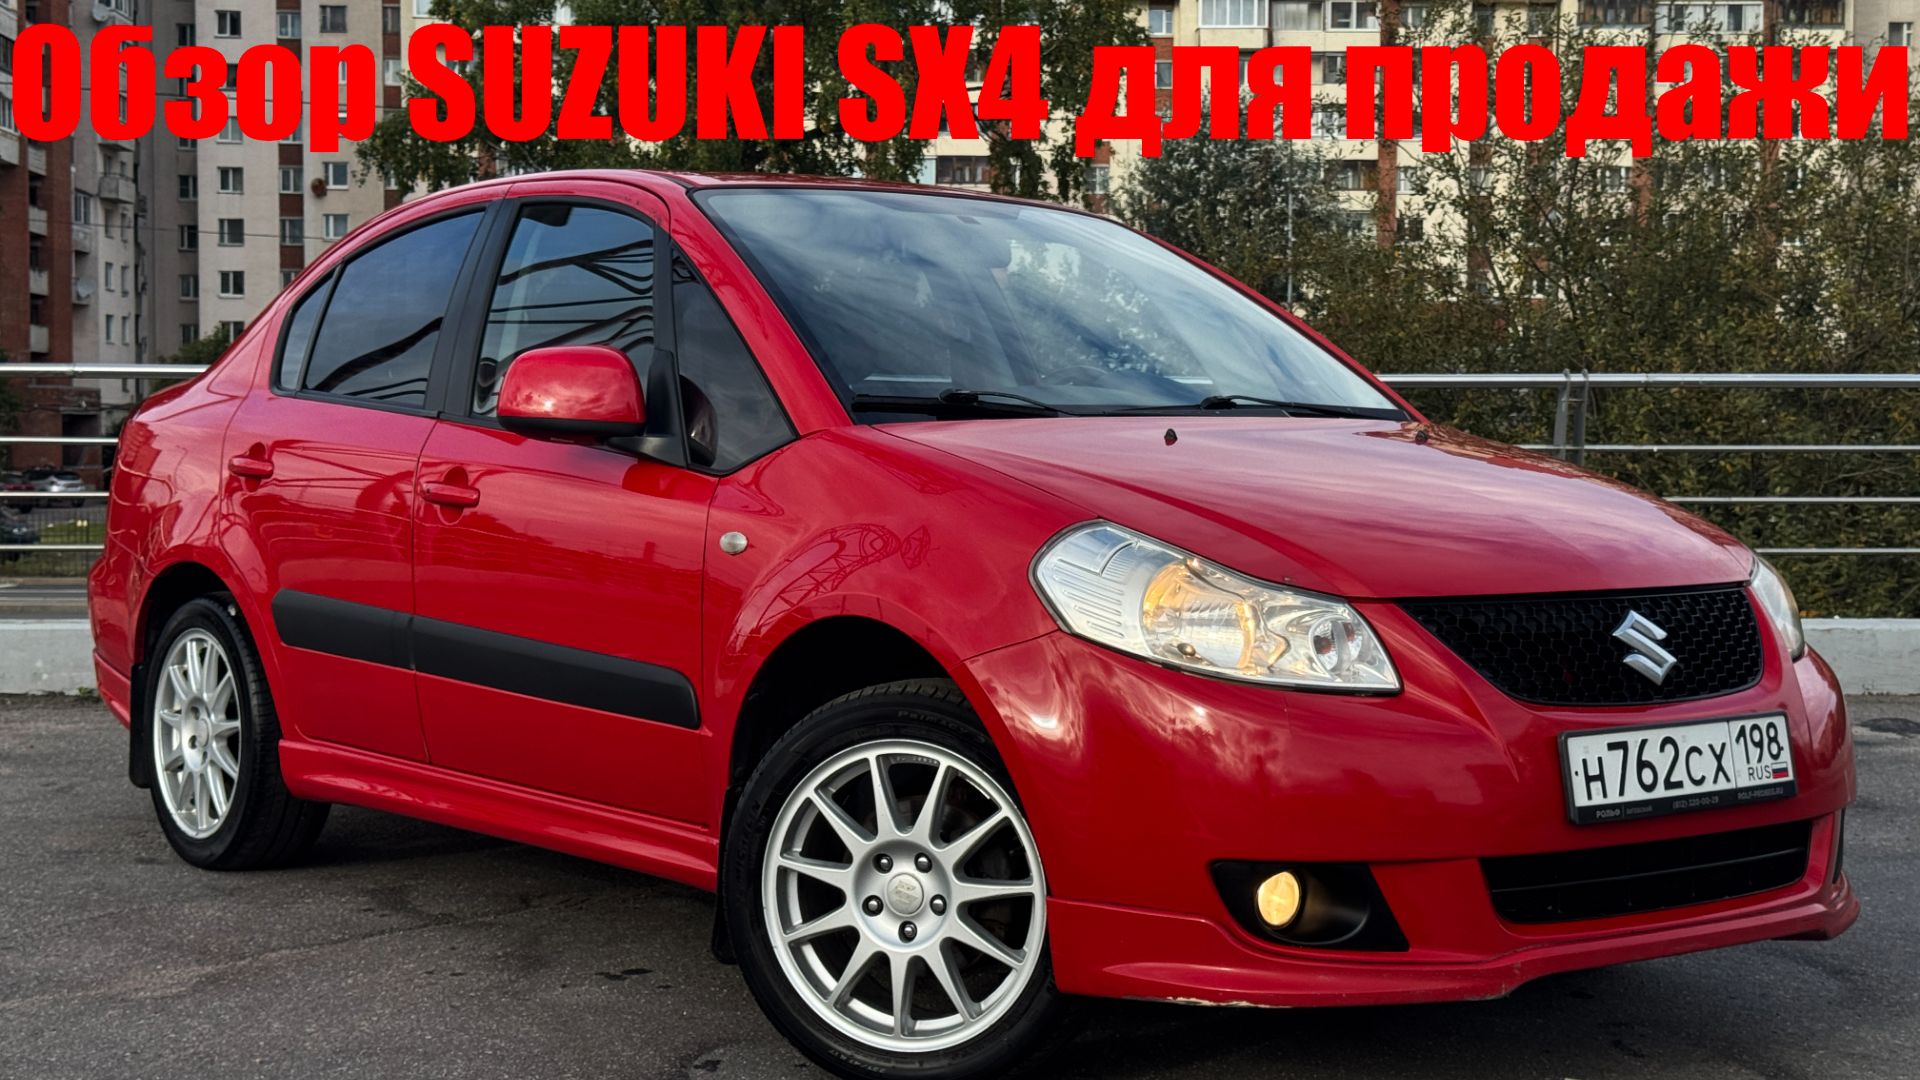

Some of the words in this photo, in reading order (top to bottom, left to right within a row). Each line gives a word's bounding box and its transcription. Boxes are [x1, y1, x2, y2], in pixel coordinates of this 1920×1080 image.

[1581, 736, 1731, 801] Н762СХ
[1735, 721, 1781, 764] 198
[1748, 765, 1771, 781] RUS
